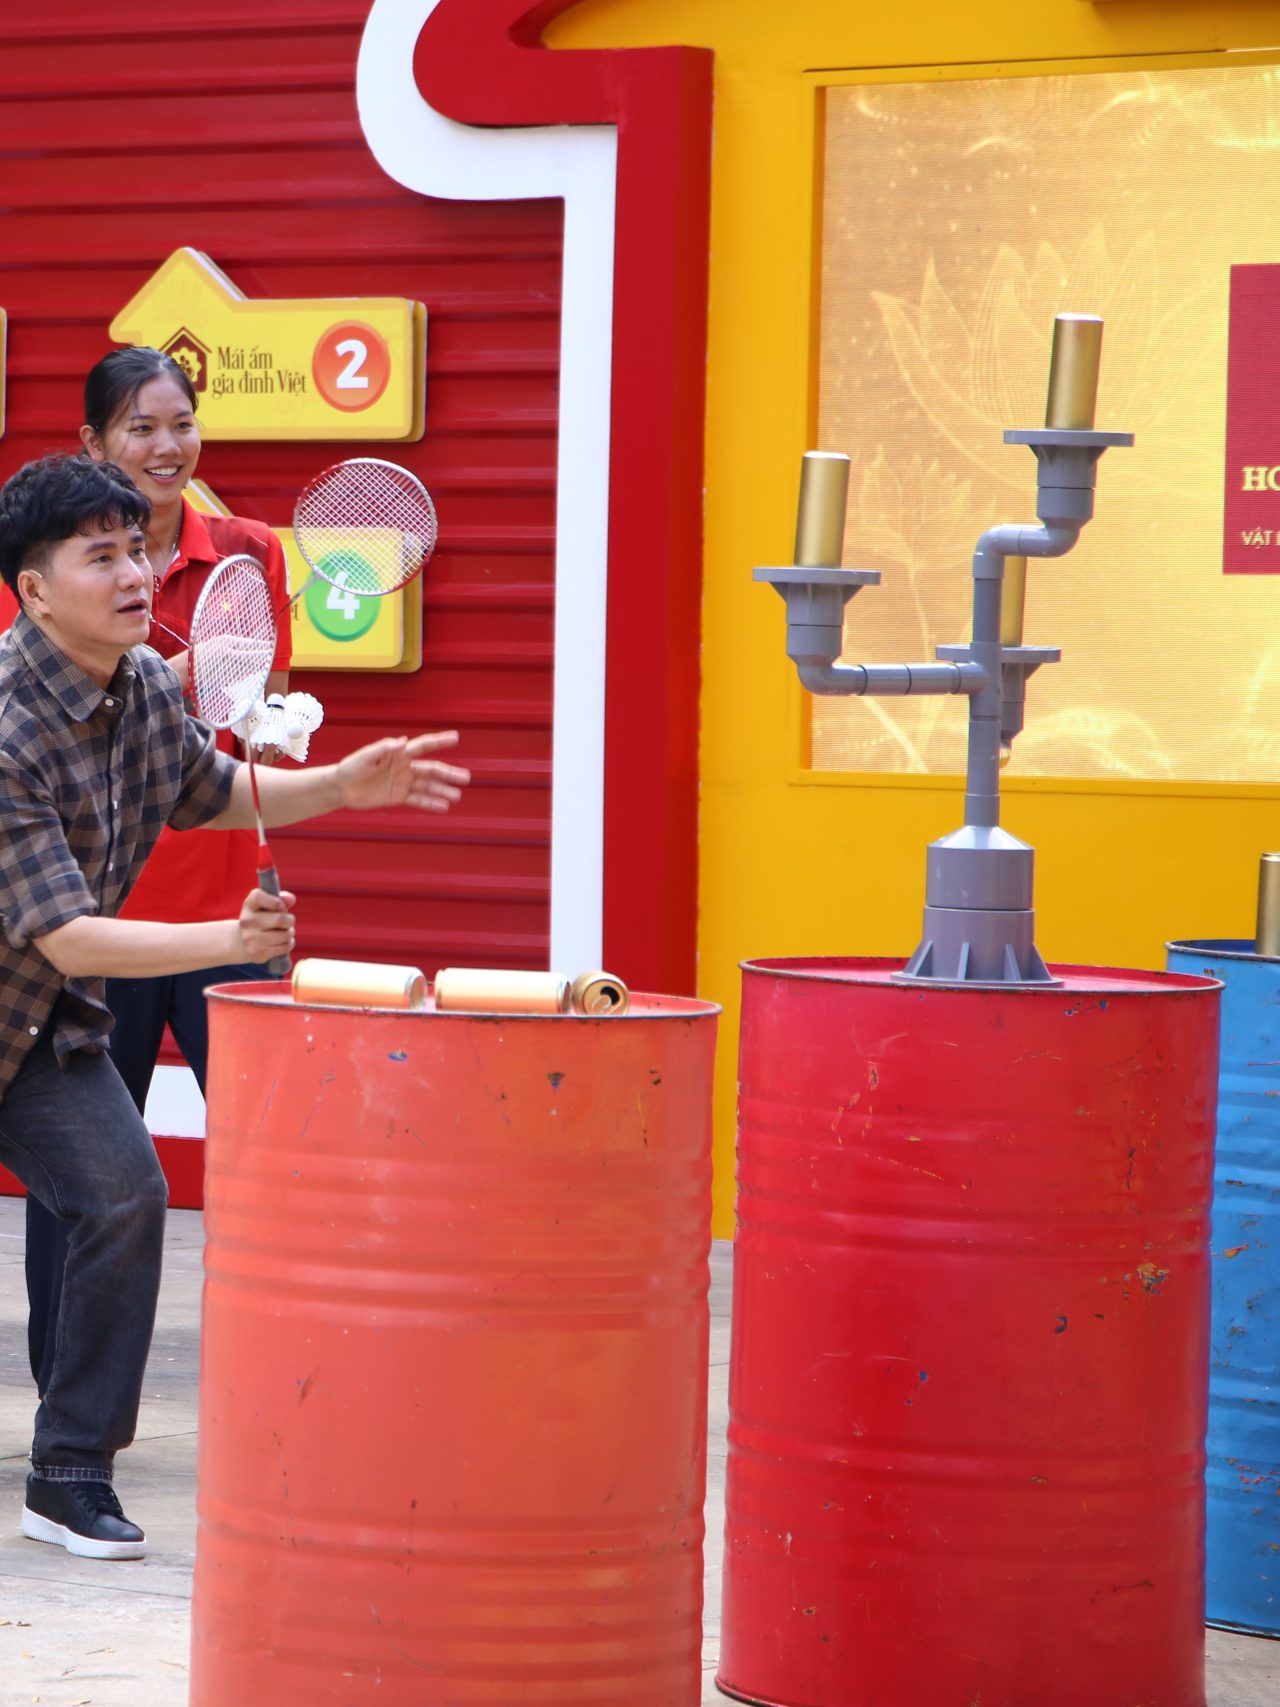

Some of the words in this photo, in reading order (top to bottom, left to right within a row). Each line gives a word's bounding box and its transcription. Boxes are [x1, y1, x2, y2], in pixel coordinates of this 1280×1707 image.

[217, 346, 245, 369] Mái
[249, 345, 273, 369] ấm
[335, 339, 369, 389] 2
[212, 374, 234, 399] gia
[239, 371, 274, 394] đình
[277, 370, 307, 397] Việt
[1241, 526, 1273, 549] VẬT
[326, 570, 360, 620] 4
